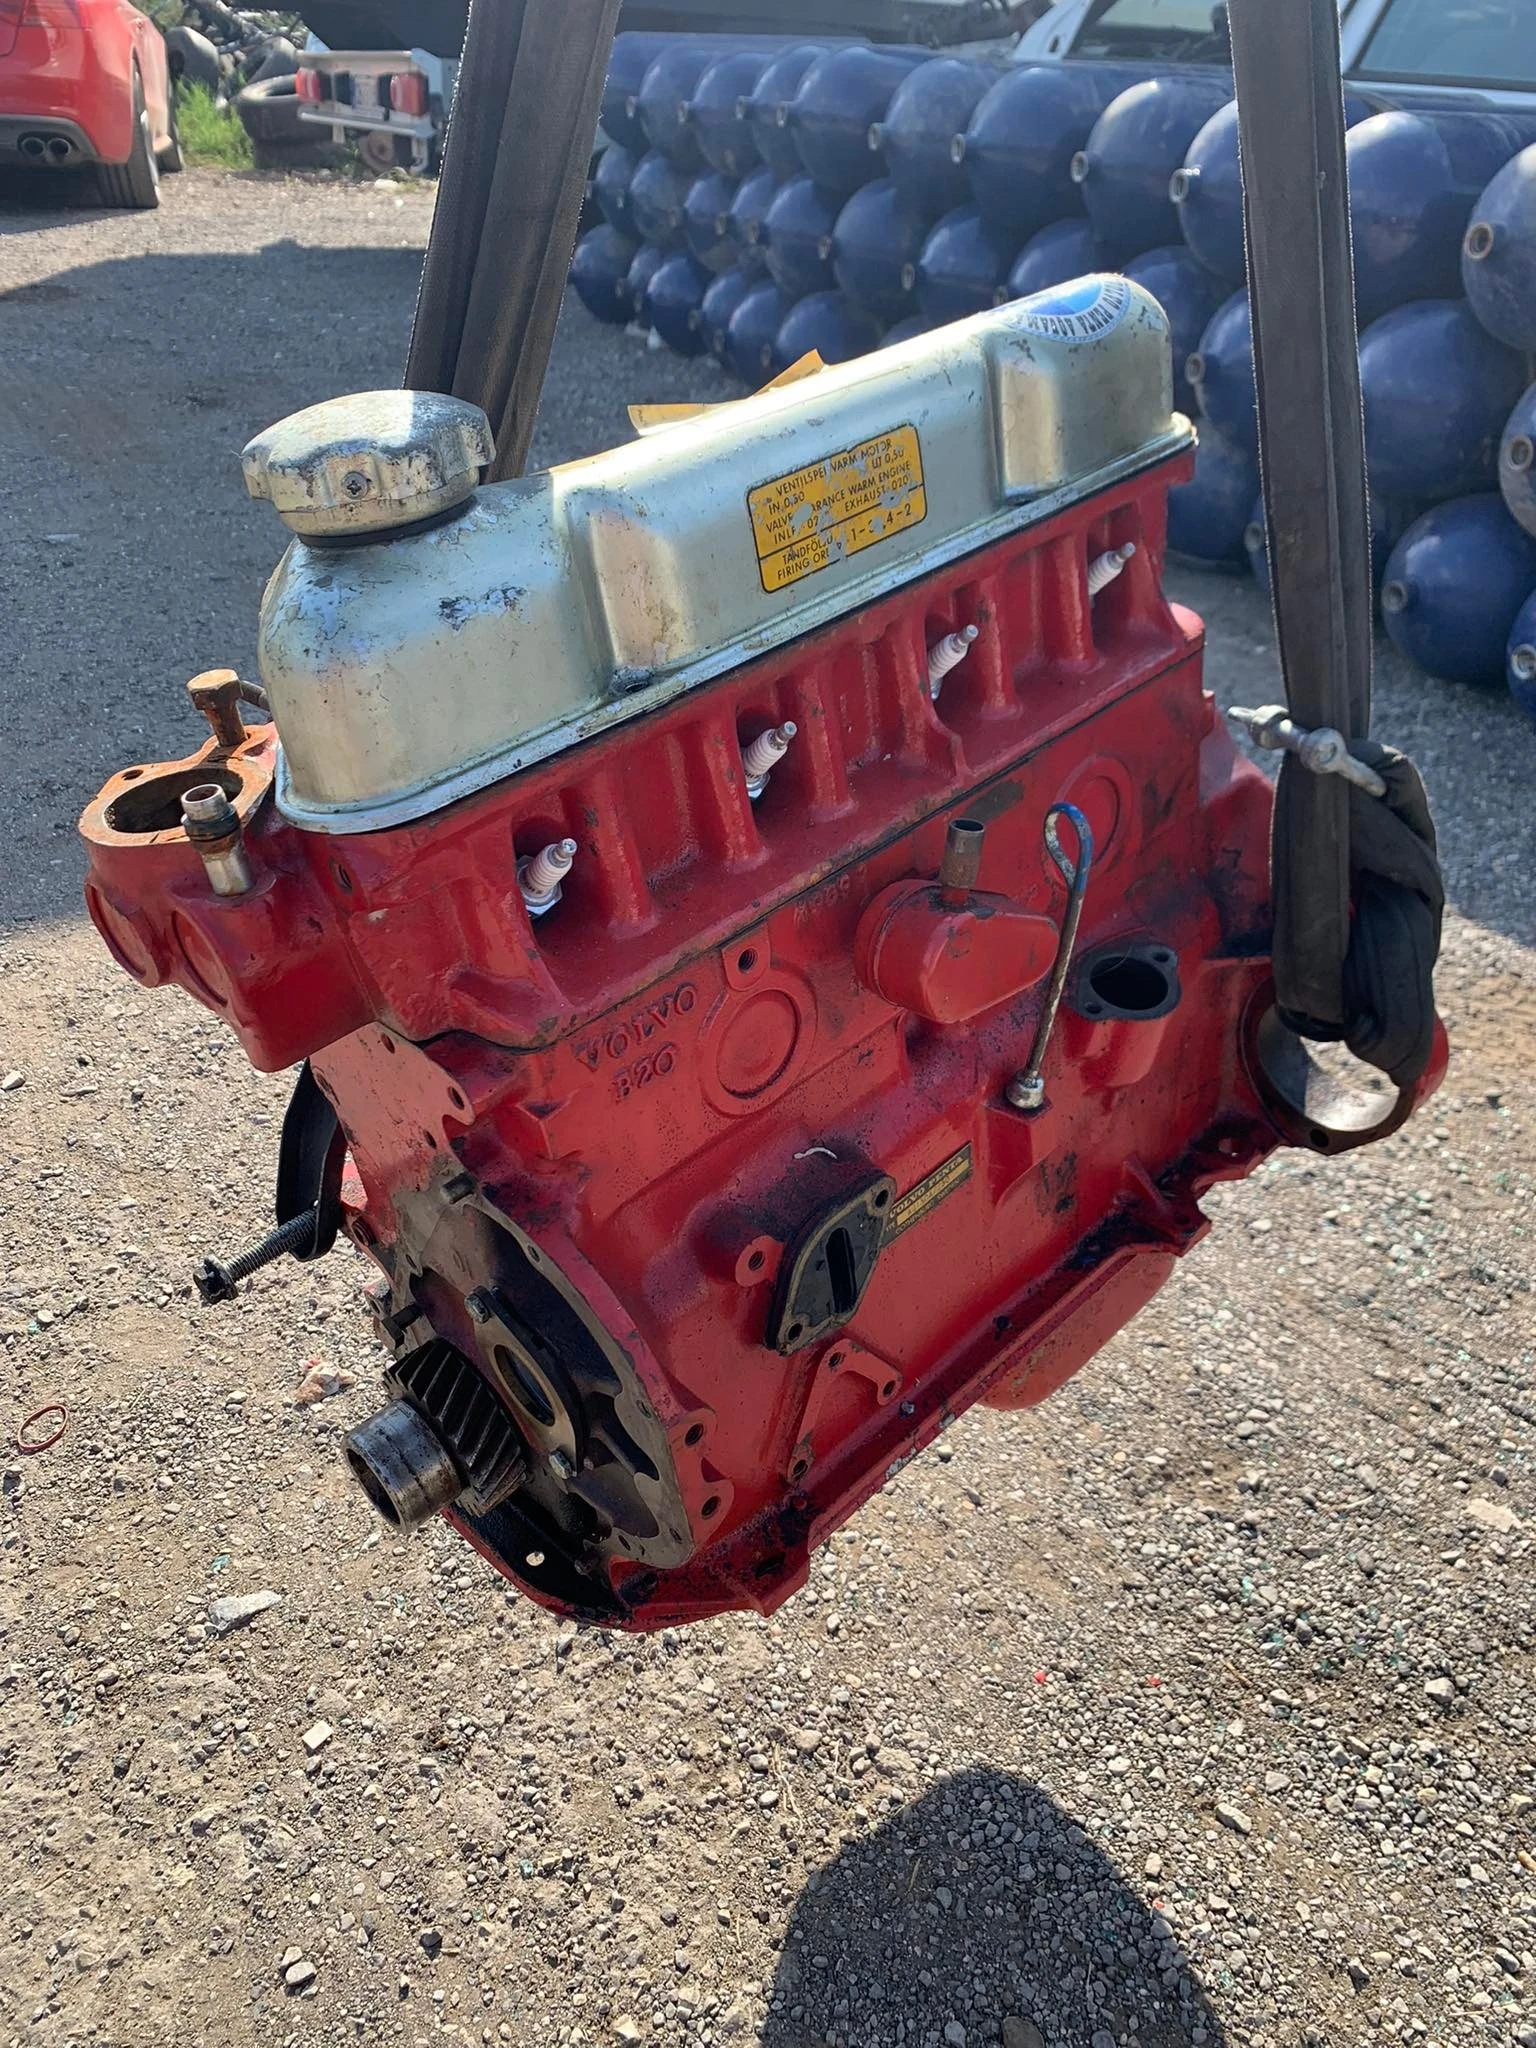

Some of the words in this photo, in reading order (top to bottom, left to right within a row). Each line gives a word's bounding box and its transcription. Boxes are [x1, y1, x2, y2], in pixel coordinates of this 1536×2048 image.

[1076, 303, 1114, 335] PENTA
[831, 452, 858, 473] VARM
[848, 475, 877, 496] WARM
[878, 460, 912, 483] ENGINE
[768, 499, 783, 516] IN
[844, 486, 887, 513] EXHAUST
[777, 558, 811, 582] FIRING
[570, 982, 698, 1073] VOLVO
[611, 1041, 678, 1104] B20
[889, 1186, 926, 1219] VOLVO
[928, 1156, 964, 1190] PENTA
